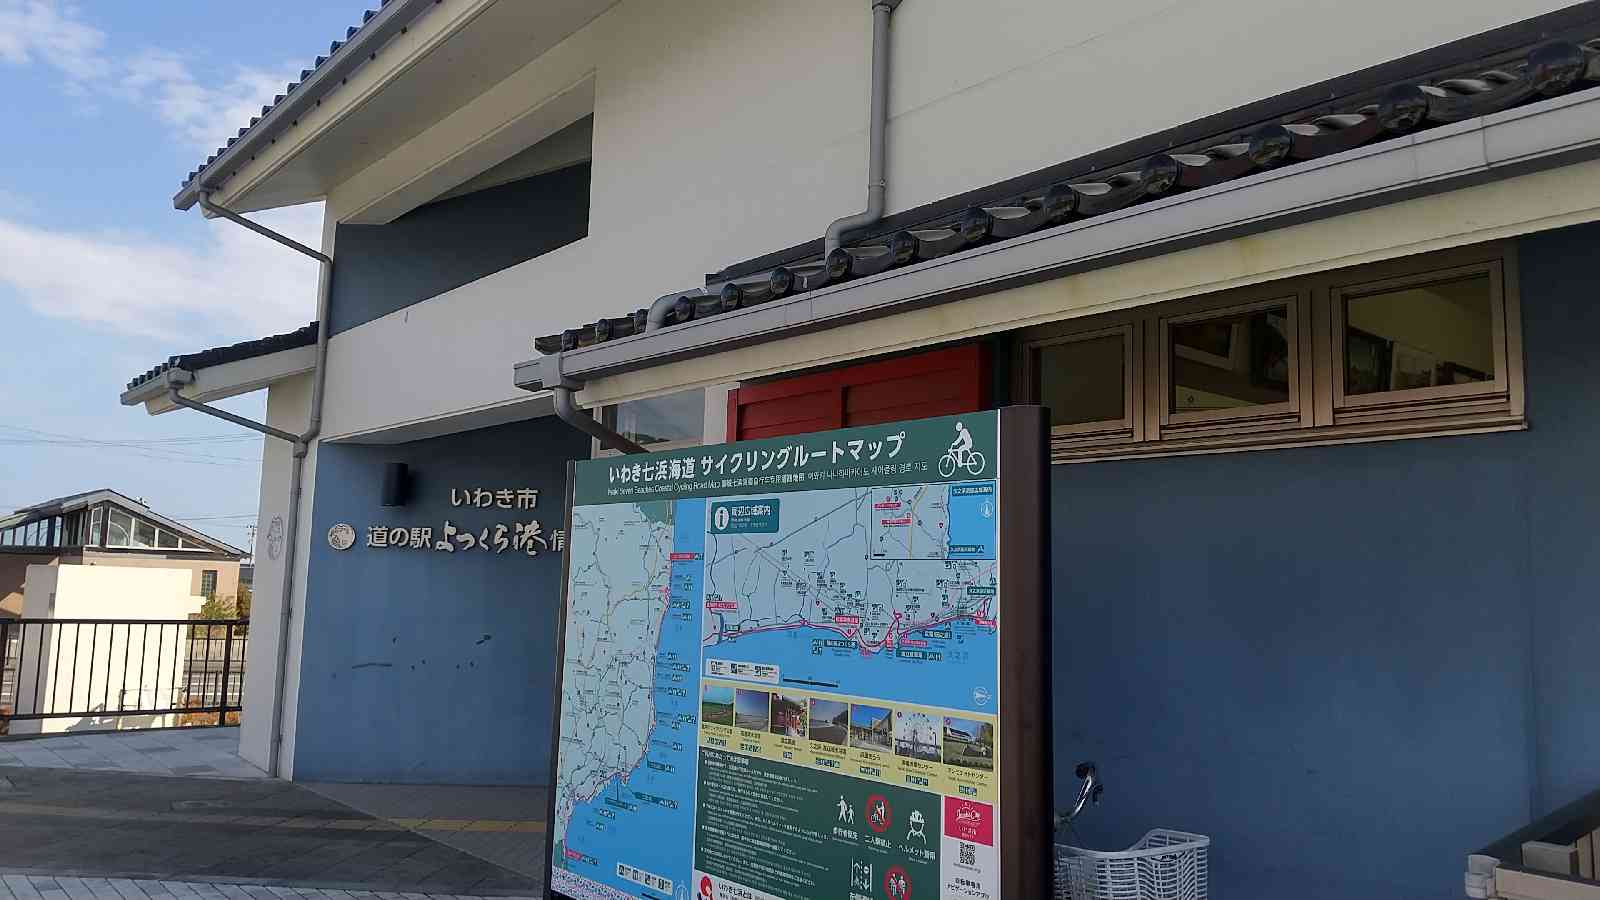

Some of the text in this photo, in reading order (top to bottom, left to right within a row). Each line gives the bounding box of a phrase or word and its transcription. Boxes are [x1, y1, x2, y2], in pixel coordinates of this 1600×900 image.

[608, 431, 906, 483] いわき七浜海道 サイクリングルートマップ
[451, 487, 539, 510] いわき市
